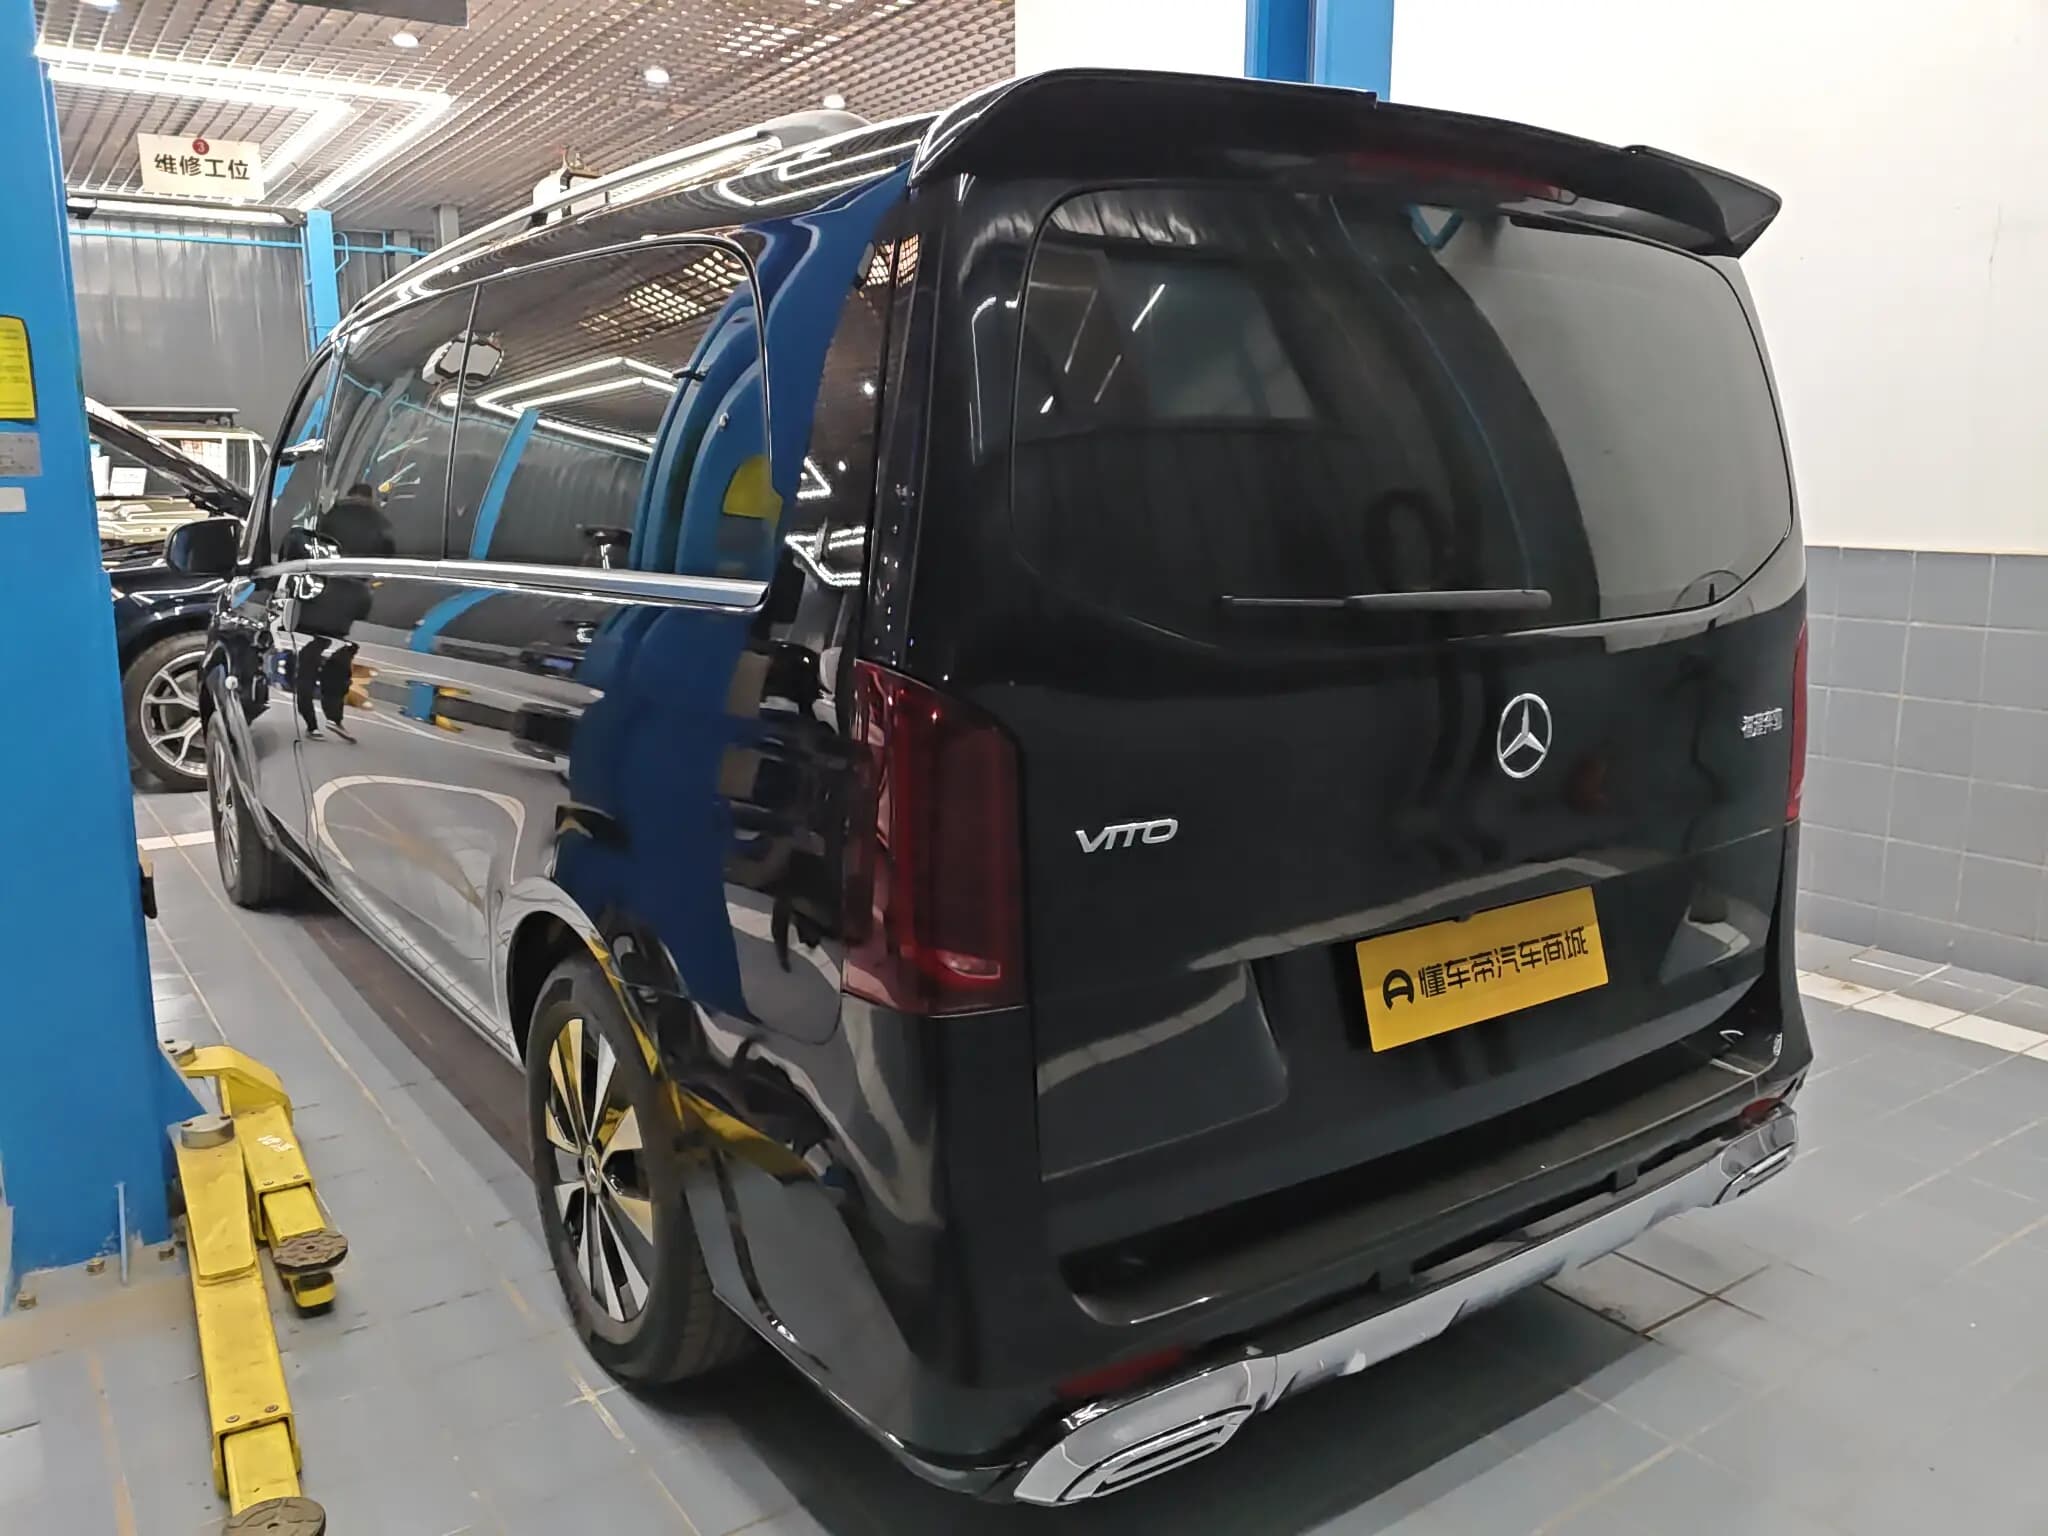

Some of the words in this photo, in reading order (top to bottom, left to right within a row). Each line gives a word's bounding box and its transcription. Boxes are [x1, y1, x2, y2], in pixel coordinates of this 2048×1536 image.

[154, 153, 250, 180] 维修工位
[1075, 818, 1178, 853] VITO
[1417, 925, 1589, 998] 懂车帝汽车商城
